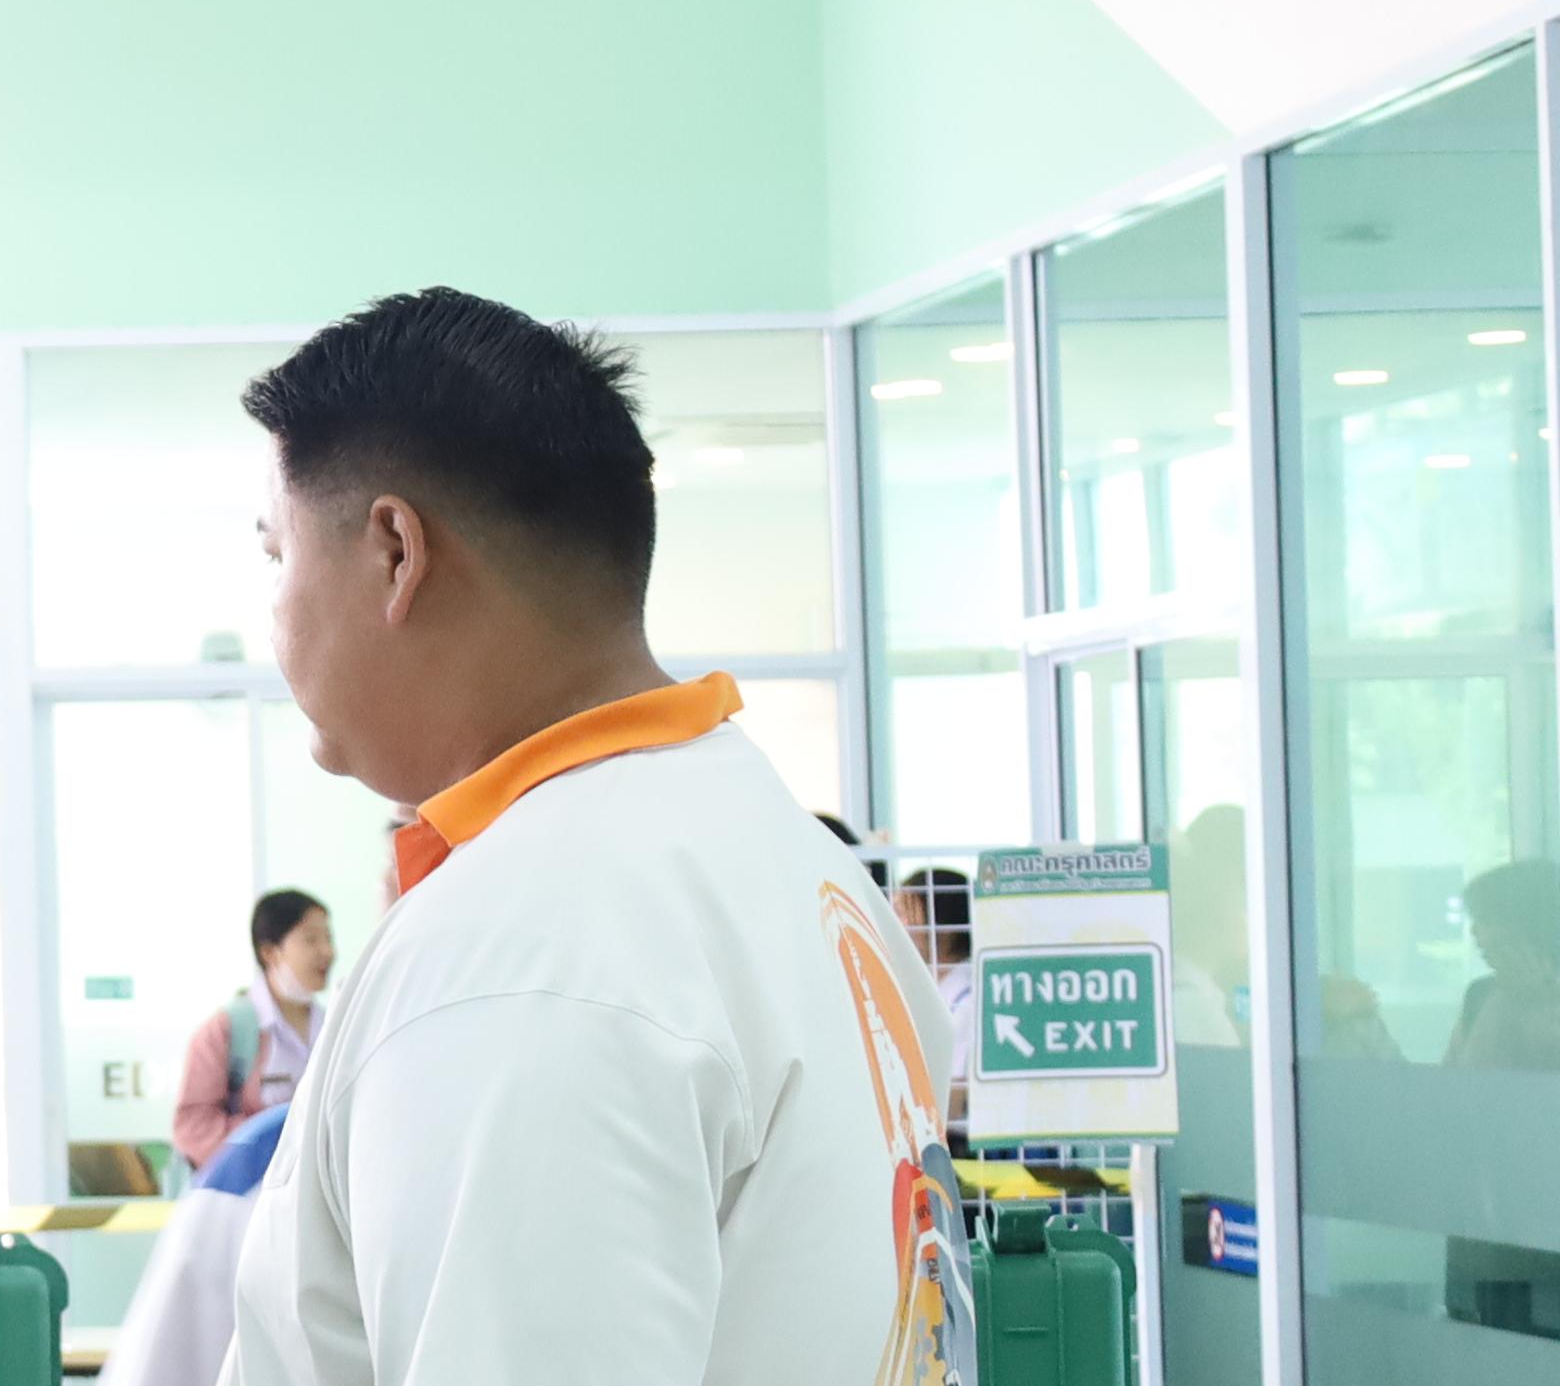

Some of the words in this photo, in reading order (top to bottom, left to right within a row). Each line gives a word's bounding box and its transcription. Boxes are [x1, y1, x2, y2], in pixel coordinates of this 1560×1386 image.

[990, 968, 1138, 1005] ทางออก
[1044, 1020, 1140, 1052] EXIT
